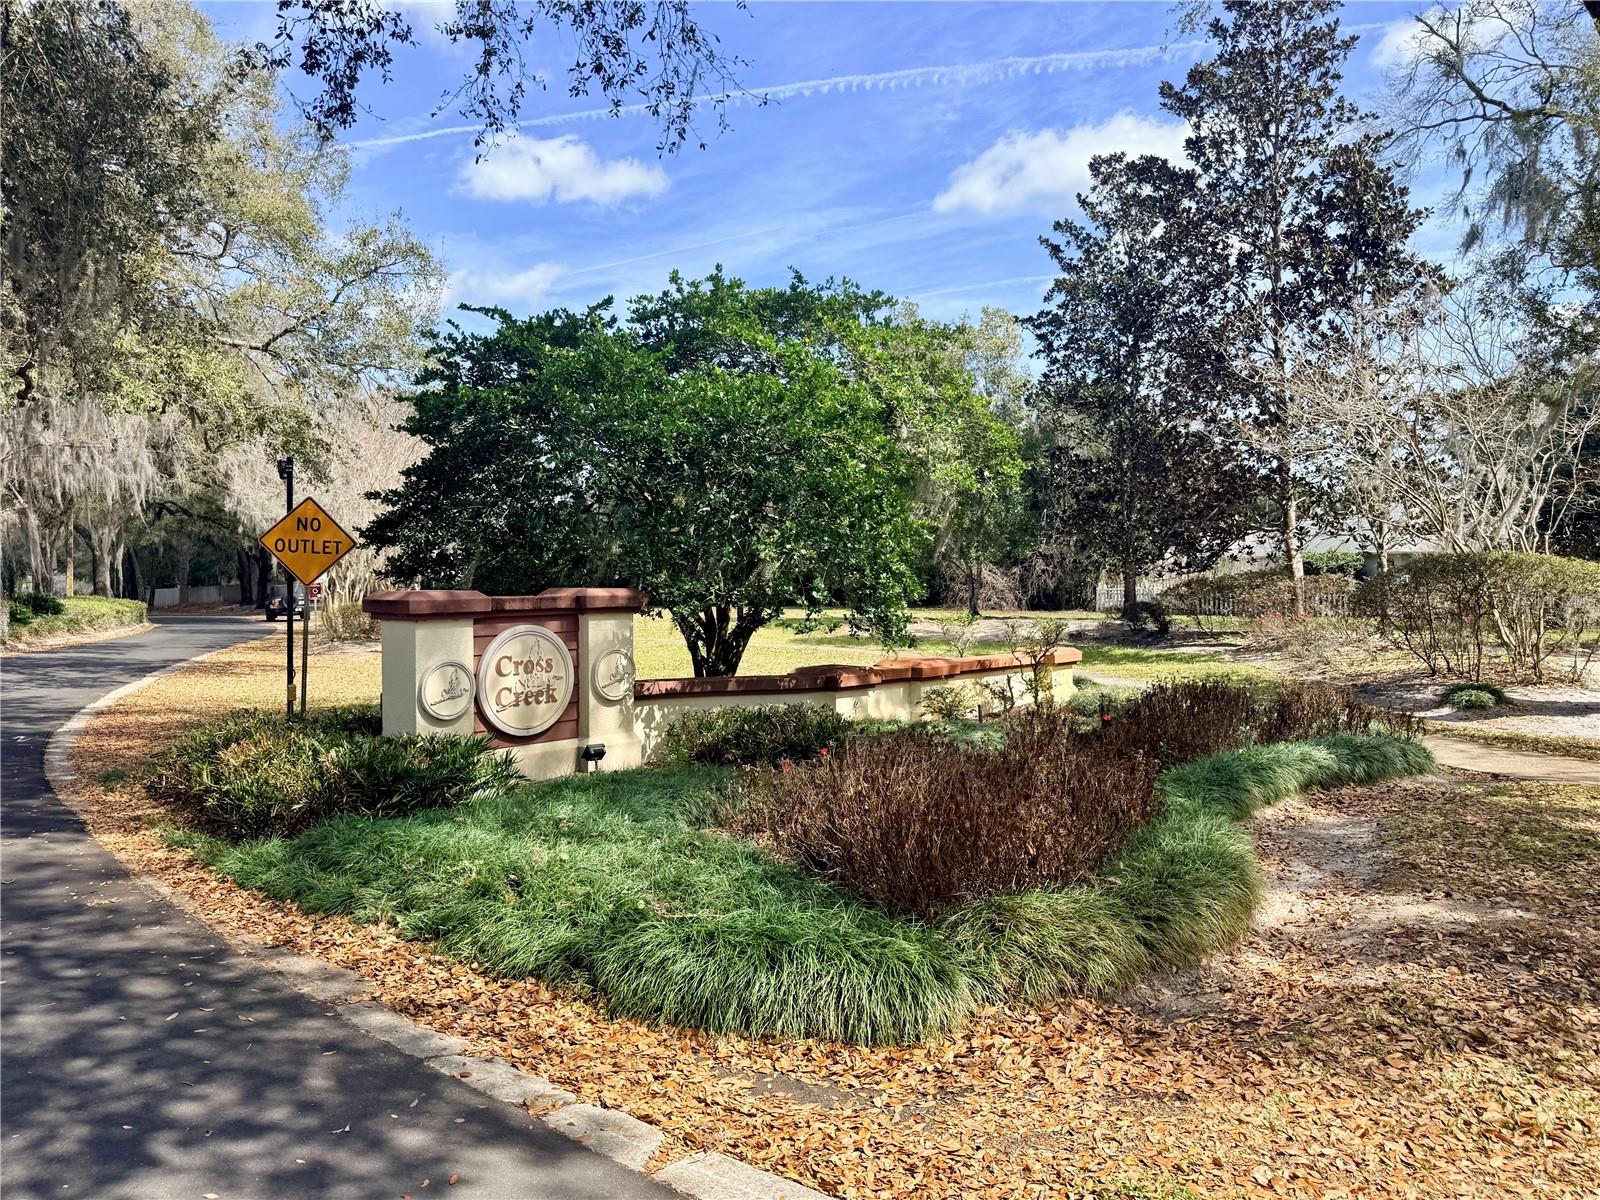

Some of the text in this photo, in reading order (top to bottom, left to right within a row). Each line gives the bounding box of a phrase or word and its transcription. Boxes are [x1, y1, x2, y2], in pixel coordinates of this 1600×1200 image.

[296, 517, 321, 532] NO
[274, 538, 342, 555] OUTLET
[495, 655, 554, 677] Cross
[495, 683, 558, 708] Creek
